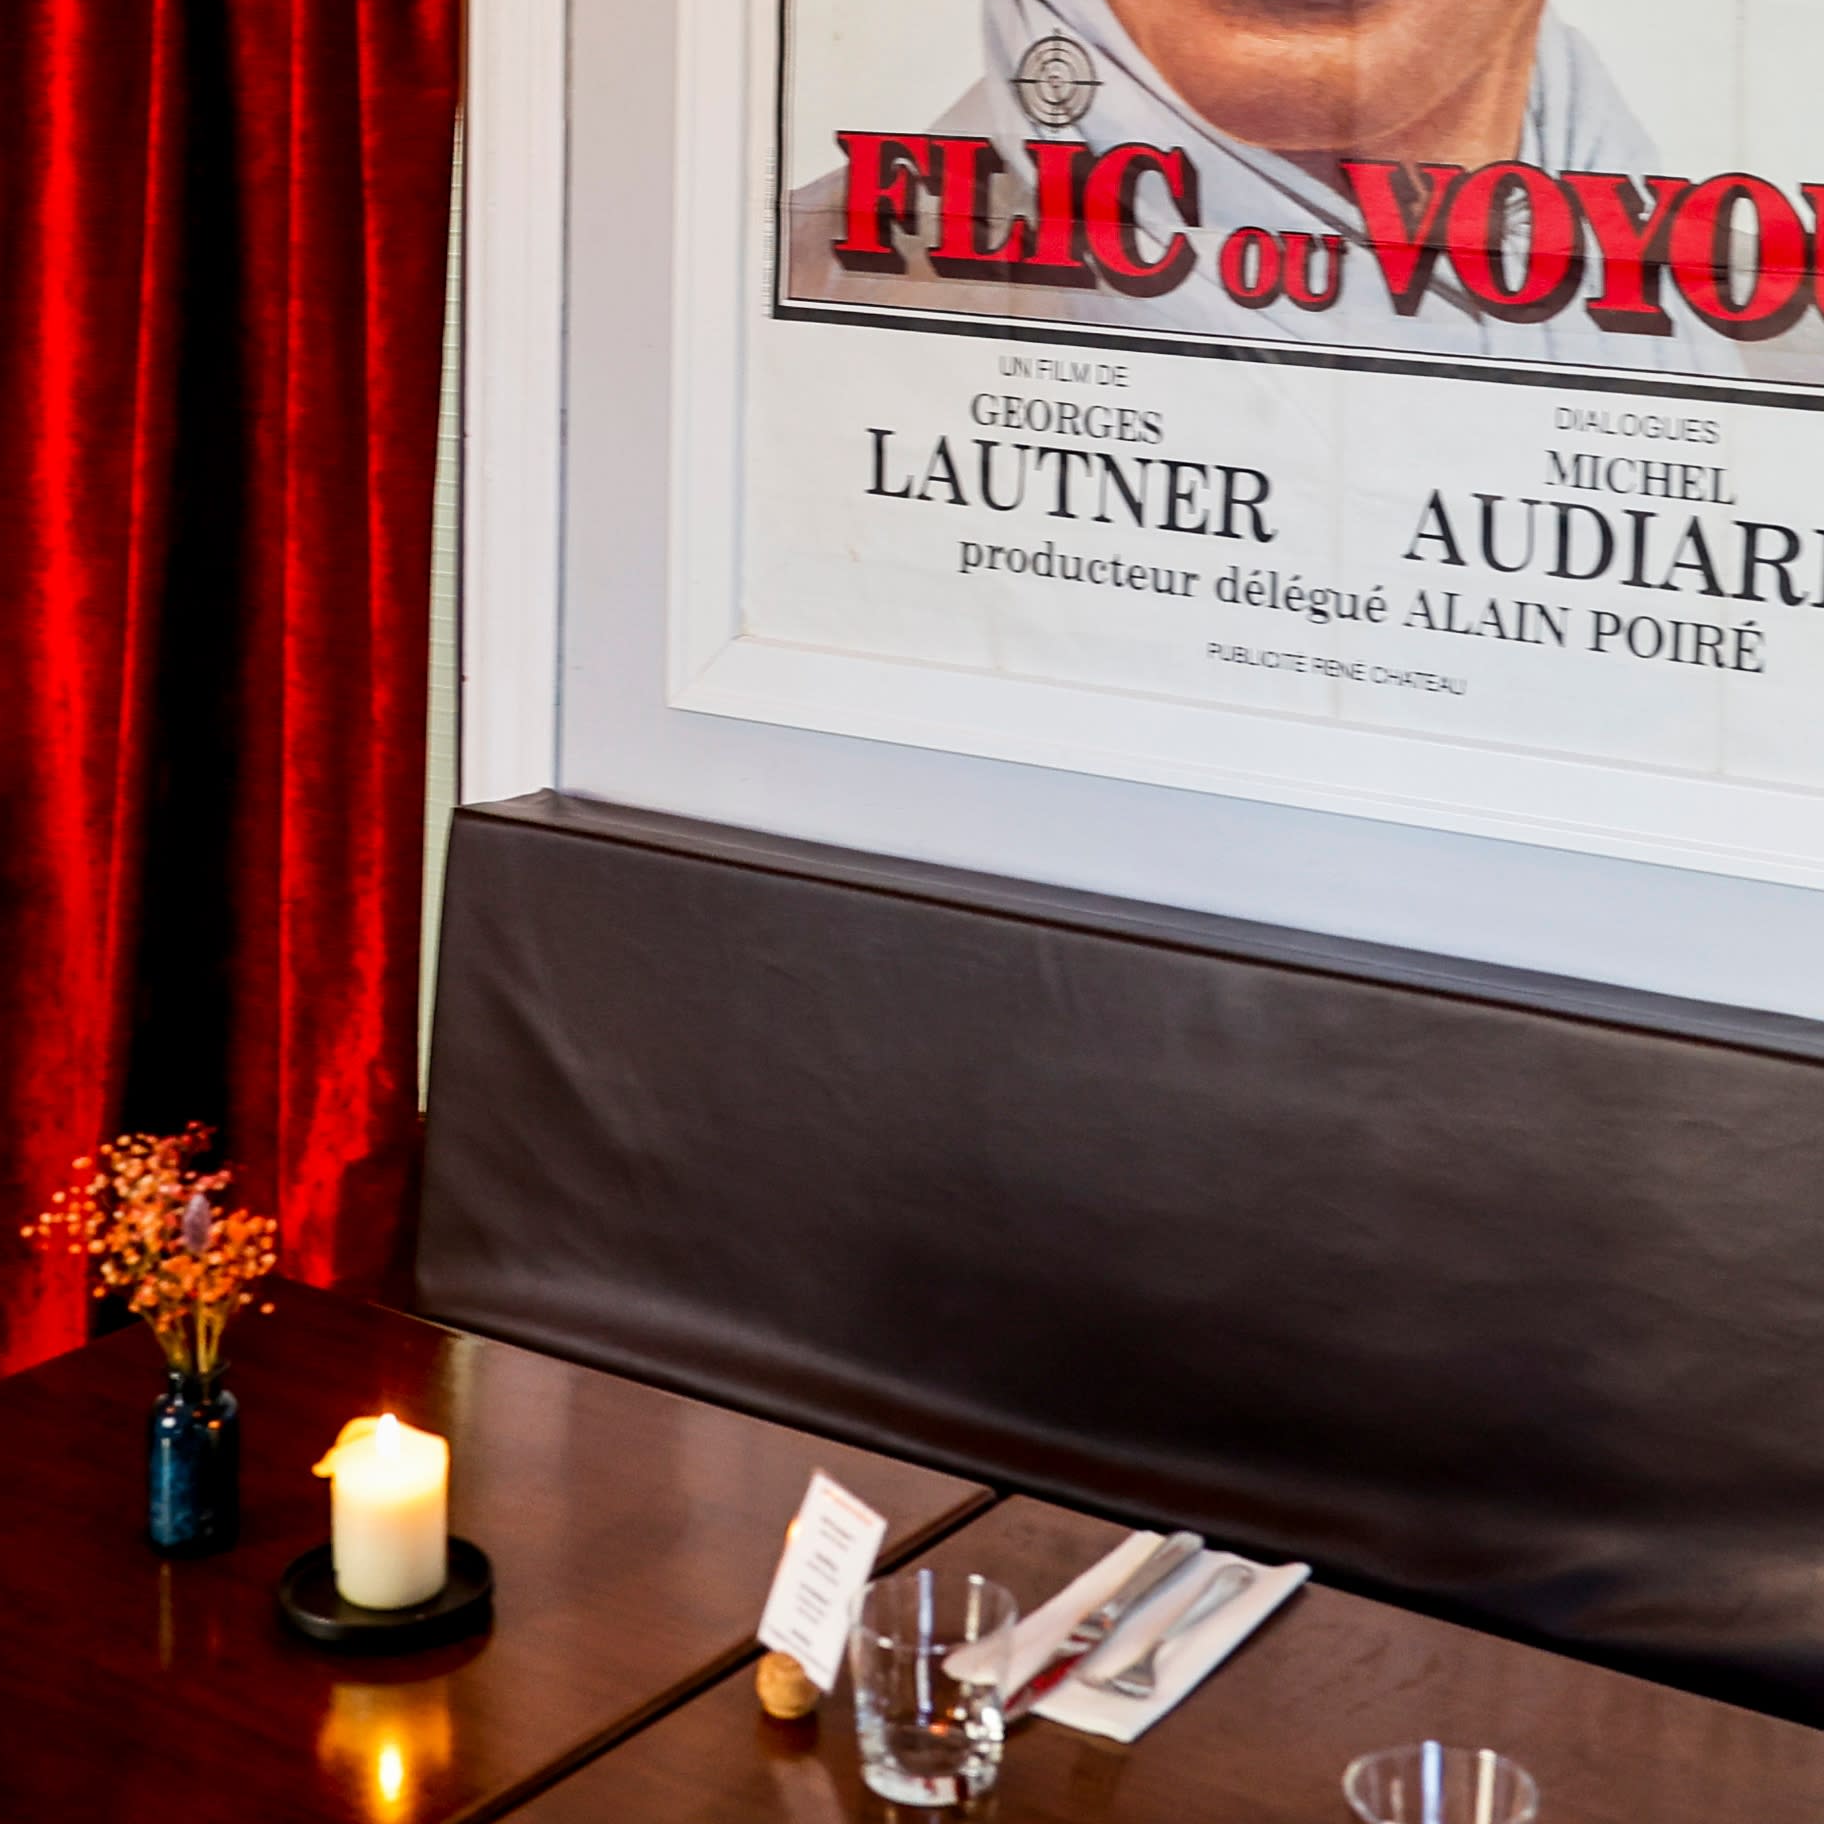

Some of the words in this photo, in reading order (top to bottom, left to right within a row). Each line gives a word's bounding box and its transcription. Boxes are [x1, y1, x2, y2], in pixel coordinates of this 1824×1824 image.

[834, 130, 1200, 298] FLIC
[999, 355, 1032, 378] UN
[1036, 360, 1091, 384] FILM
[1096, 364, 1130, 387] DE
[970, 393, 1163, 444] GEORGES
[1555, 407, 1720, 444] DIALOGUES
[865, 428, 1277, 543] LAUTNER
[1544, 450, 1736, 505] MICHEL
[960, 539, 1200, 598] producteur
[1216, 566, 1388, 626] délégué
[1402, 589, 1572, 647] ALAIN
[1589, 610, 1764, 673] POIRÉ
